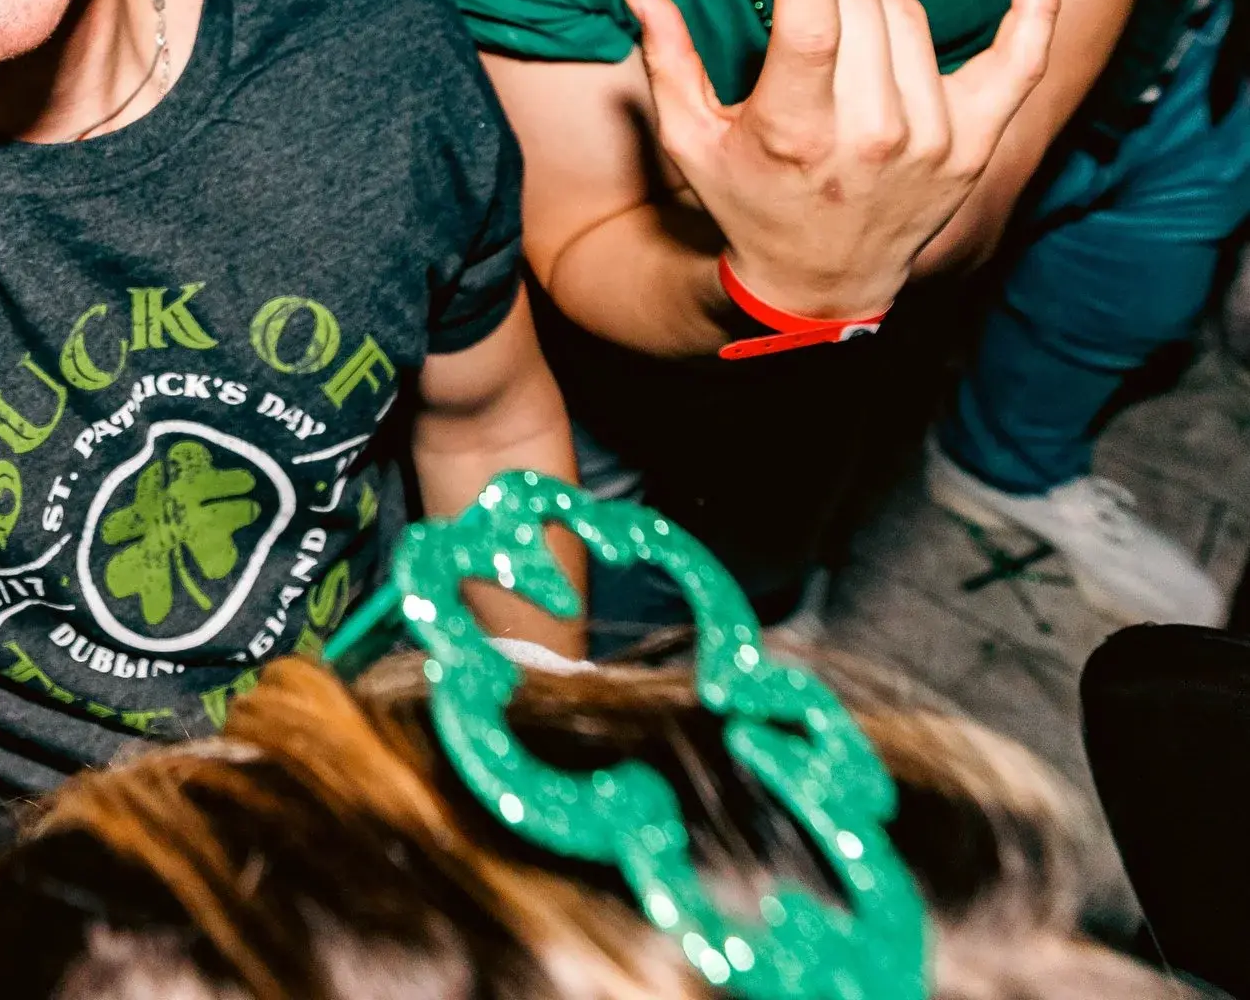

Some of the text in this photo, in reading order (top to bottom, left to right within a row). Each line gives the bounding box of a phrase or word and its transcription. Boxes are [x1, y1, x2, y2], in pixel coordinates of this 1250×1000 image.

[250, 294, 398, 409] OF
[41, 471, 79, 533] ST.
[255, 391, 327, 441] DAY
